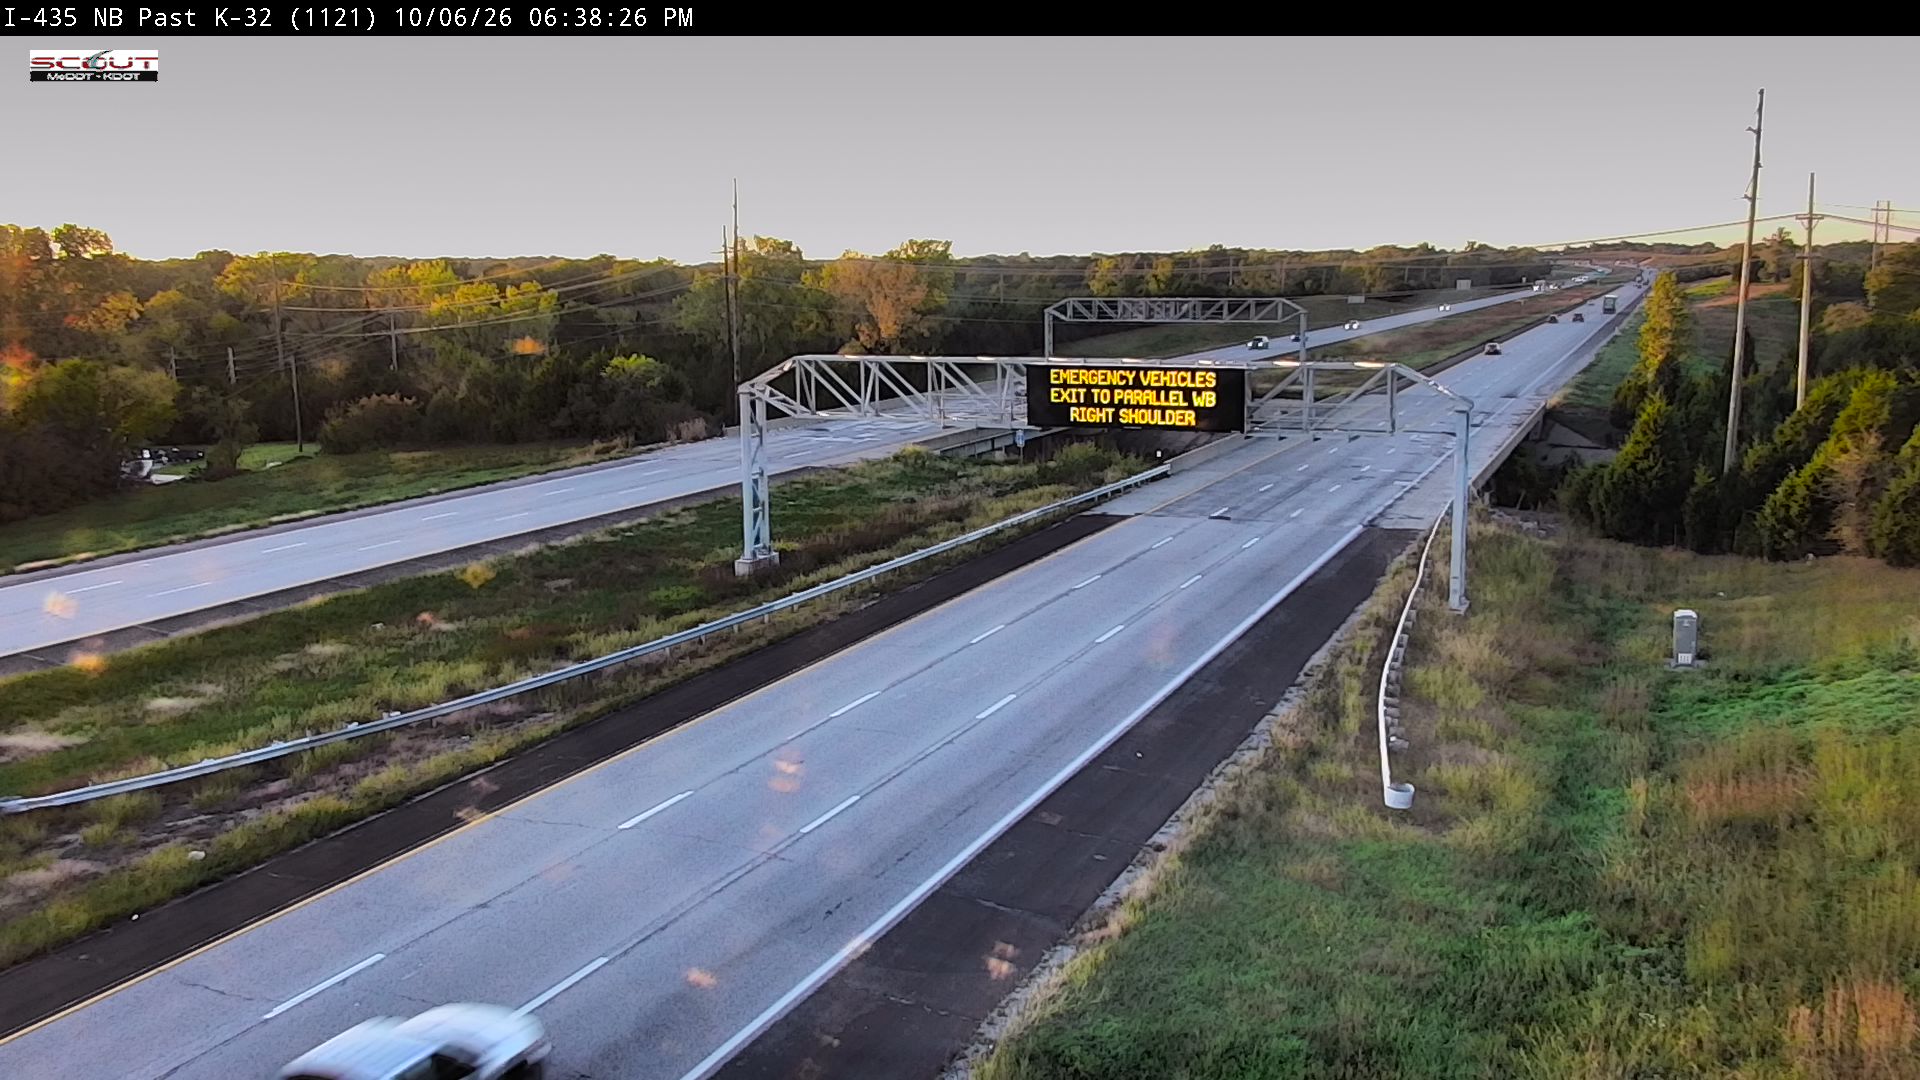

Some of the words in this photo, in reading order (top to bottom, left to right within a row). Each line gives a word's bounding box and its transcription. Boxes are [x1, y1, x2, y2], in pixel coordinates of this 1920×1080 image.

[1050, 369, 1136, 385] EMERGENCY
[1139, 371, 1217, 388] VEHICLES
[1050, 388, 1087, 404] EXIT
[1091, 388, 1111, 404] TO
[1113, 389, 1189, 407] PARALLEL
[1192, 391, 1217, 408] WB
[1070, 406, 1116, 423] RIGHT
[1118, 408, 1196, 426] SHOULDER
